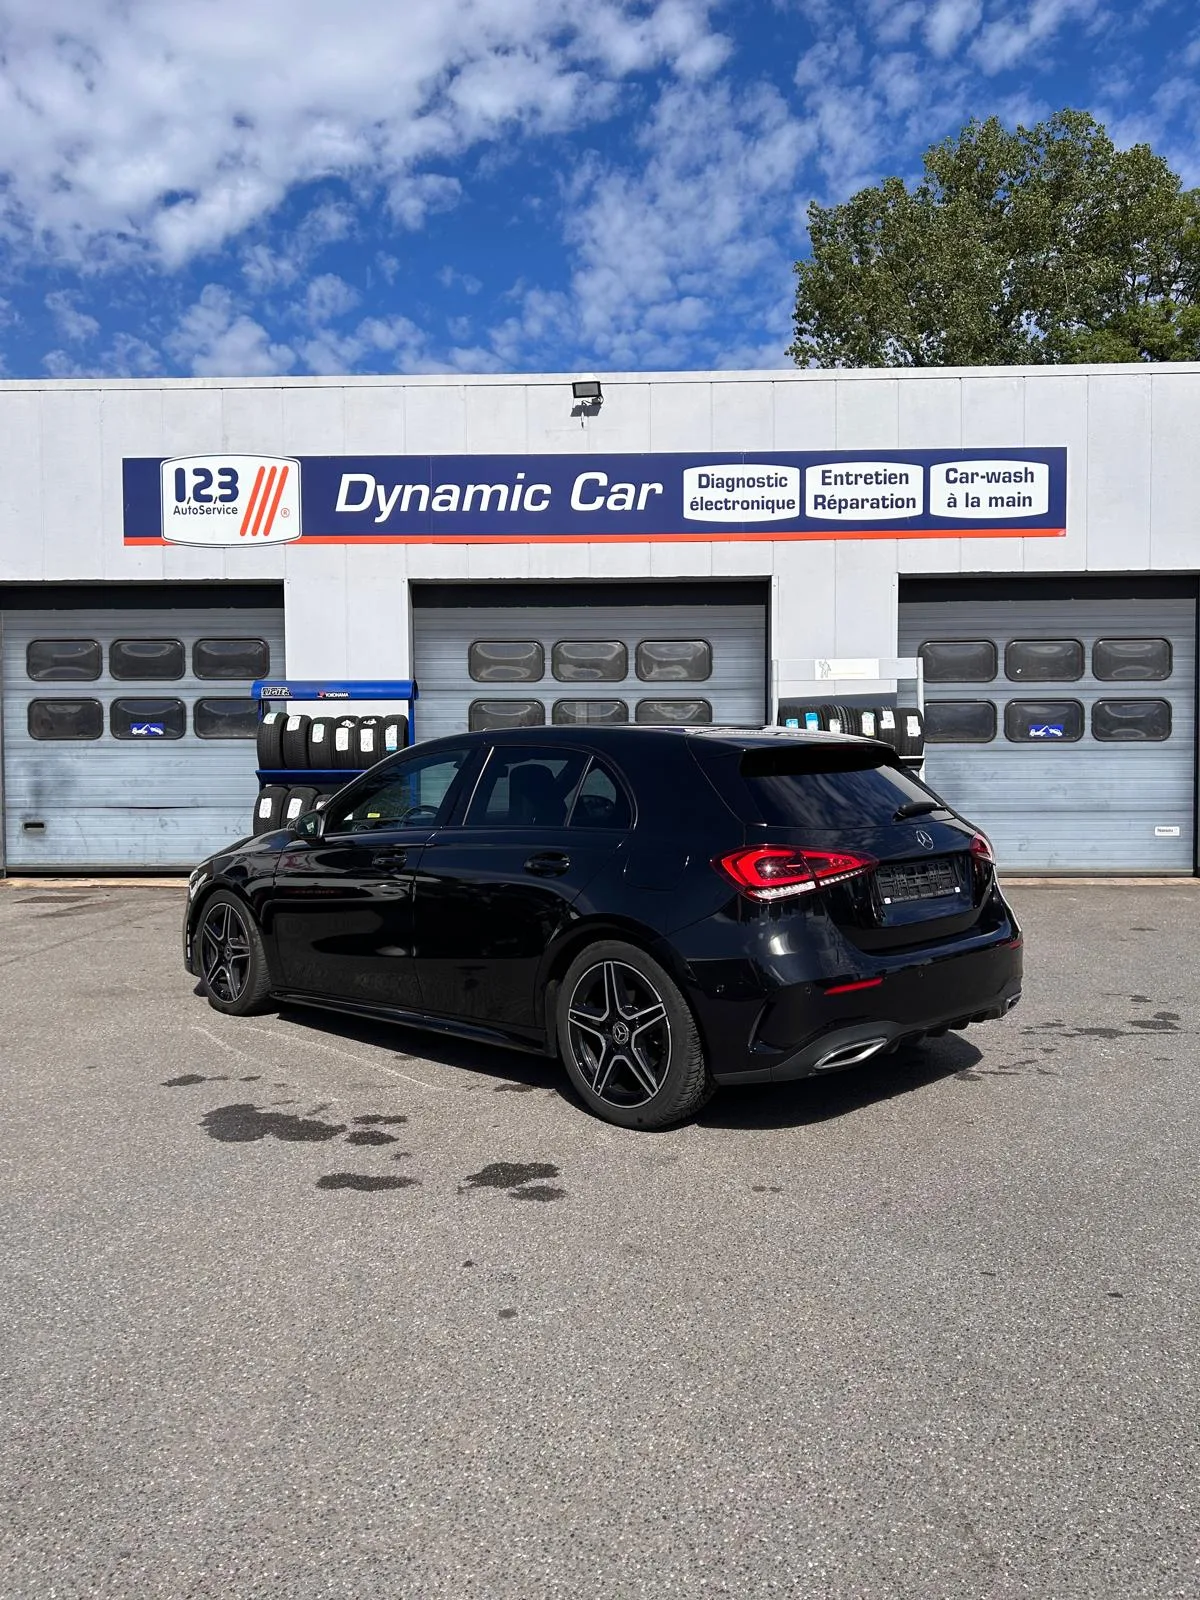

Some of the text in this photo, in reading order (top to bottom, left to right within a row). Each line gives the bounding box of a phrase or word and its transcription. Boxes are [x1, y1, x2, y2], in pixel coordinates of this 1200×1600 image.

[698, 473, 788, 492] Diagnostic
[821, 468, 909, 486] Entretien
[945, 466, 1035, 485] Car-wash
[335, 471, 664, 523] Dynamic Car
[689, 496, 796, 514] électronique
[813, 493, 917, 512] Réparation
[946, 491, 1033, 508] à la main
[173, 504, 238, 516] AutoService
